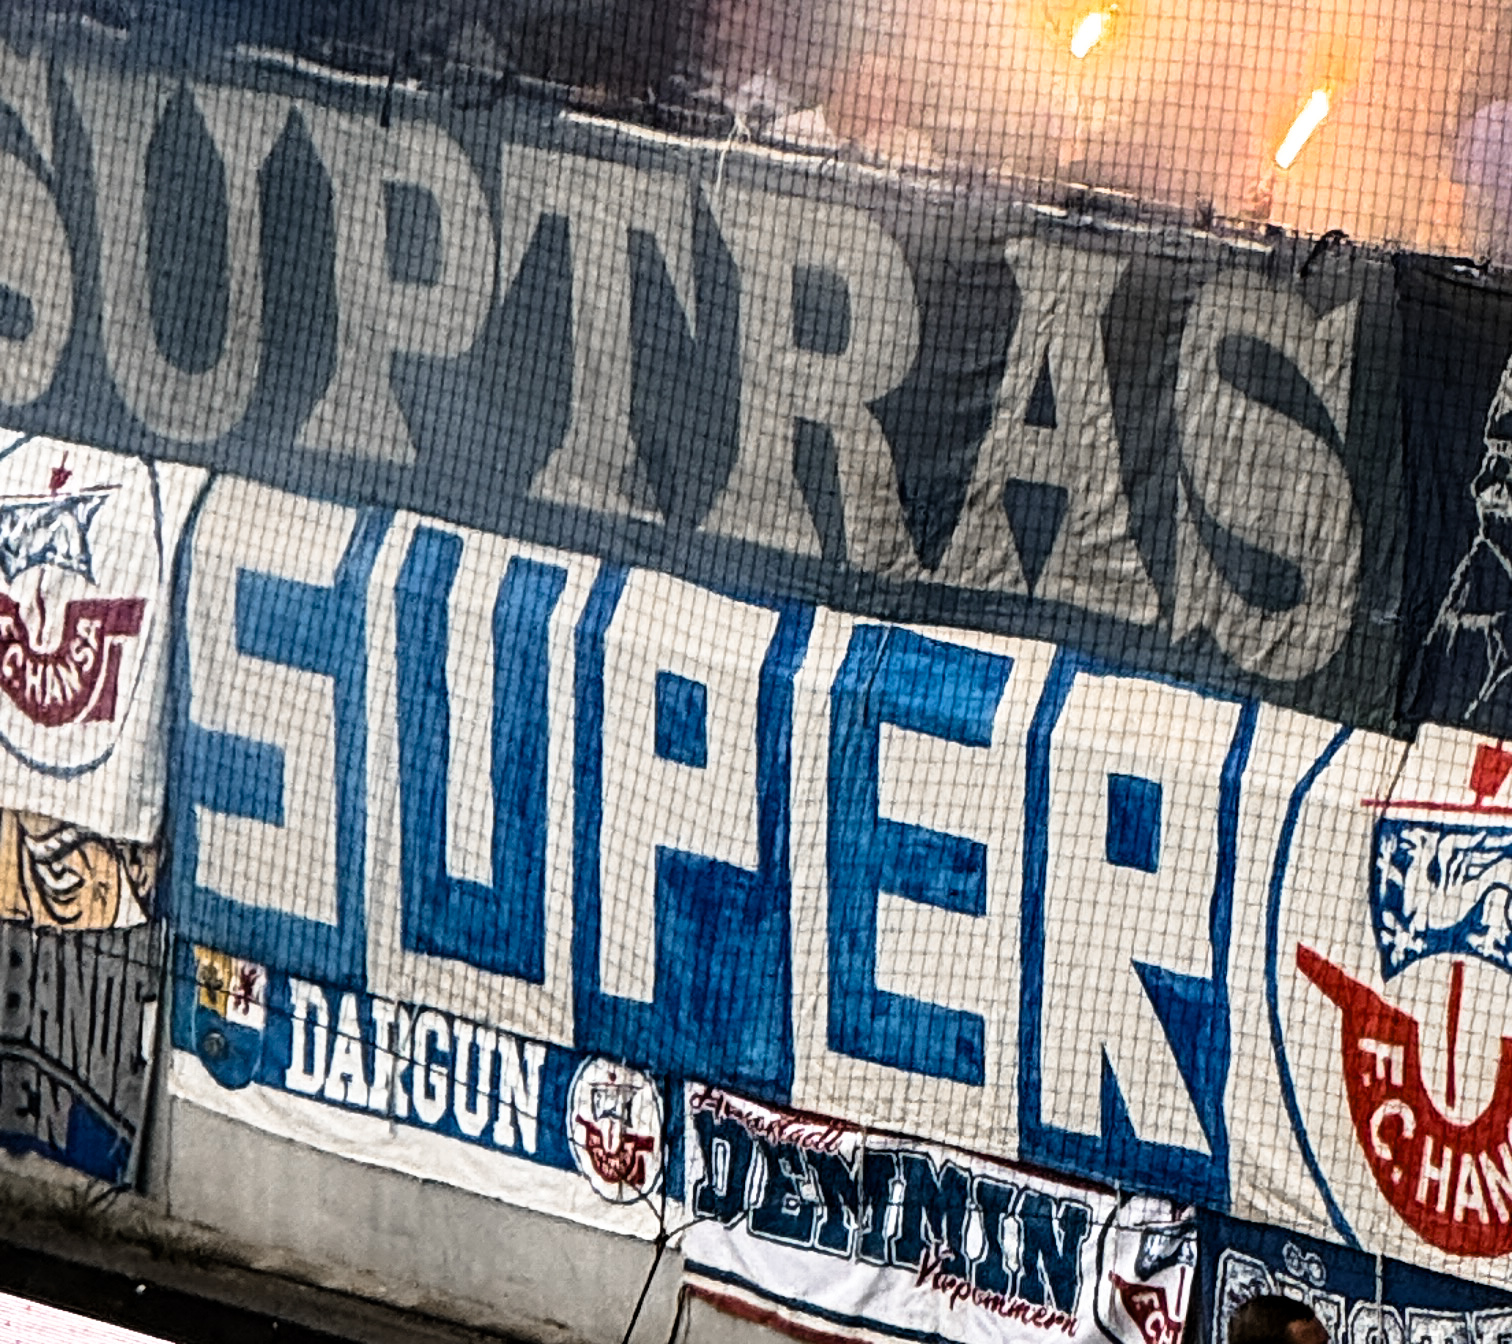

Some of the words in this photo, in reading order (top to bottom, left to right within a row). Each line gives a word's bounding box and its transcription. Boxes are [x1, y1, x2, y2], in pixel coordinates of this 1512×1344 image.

[185, 472, 1240, 1162] SUPER
[284, 976, 545, 1155] DARGUN
[693, 1112, 1093, 1312] DEMMIN
